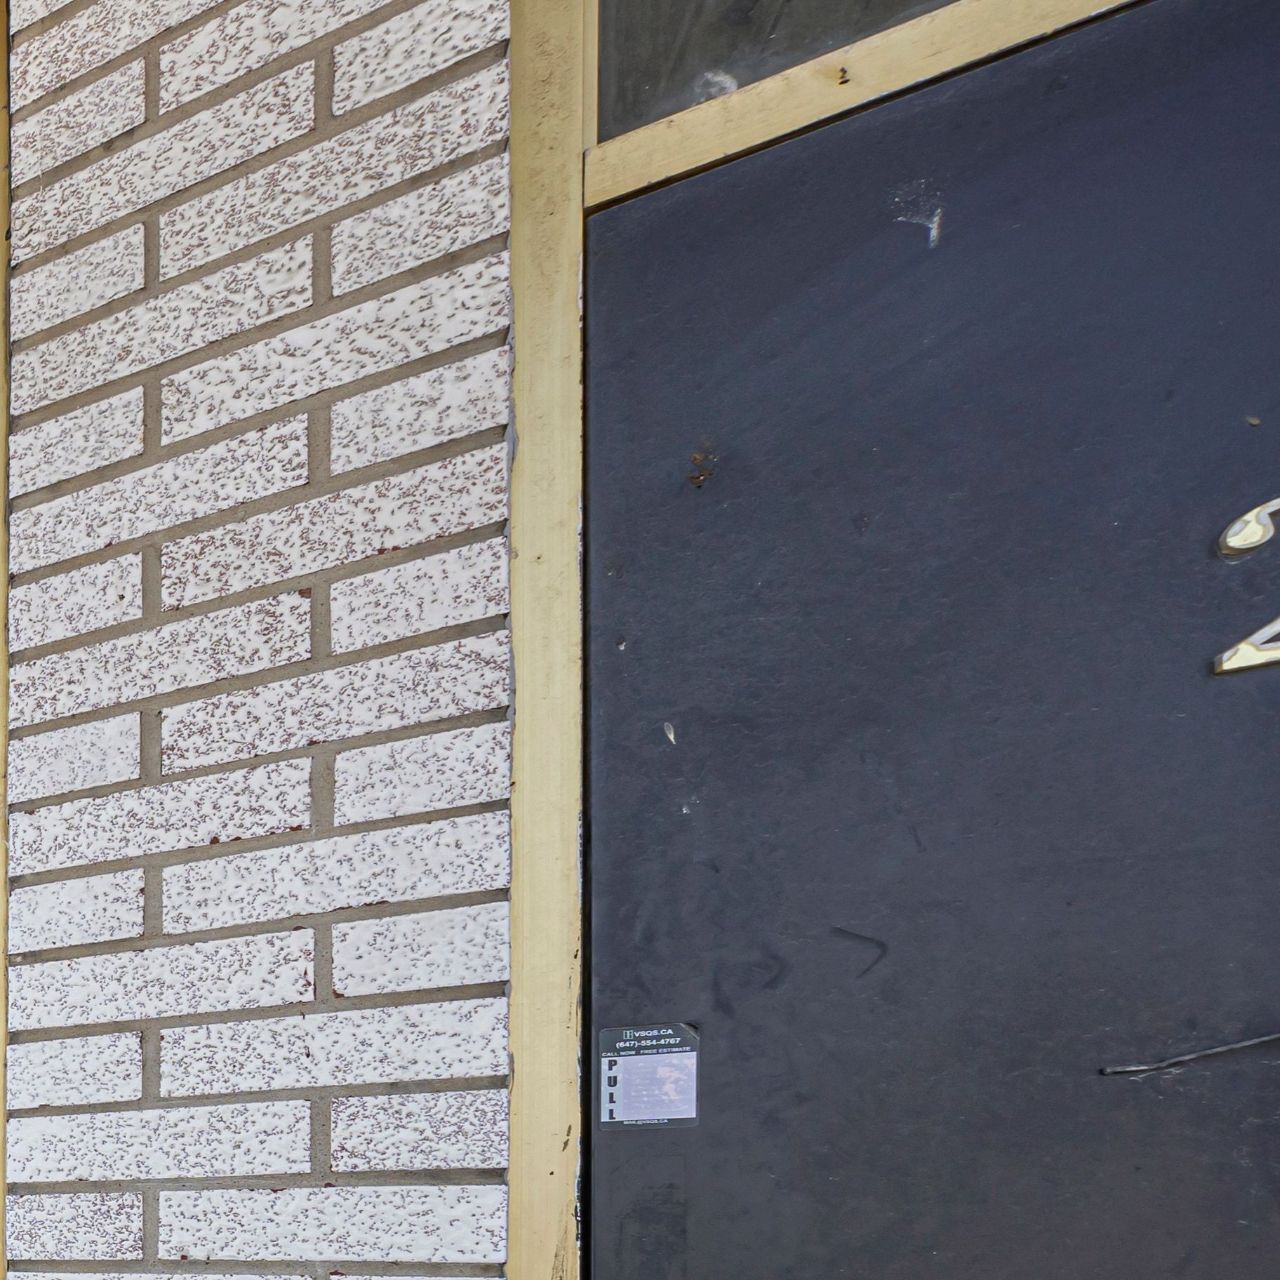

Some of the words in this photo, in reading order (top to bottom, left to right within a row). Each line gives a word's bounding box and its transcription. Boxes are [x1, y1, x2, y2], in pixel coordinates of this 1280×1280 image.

[634, 1028, 674, 1037] VSQS.CA
[615, 1037, 681, 1050] (647)-554-4767
[607, 1059, 618, 1121] PULL
